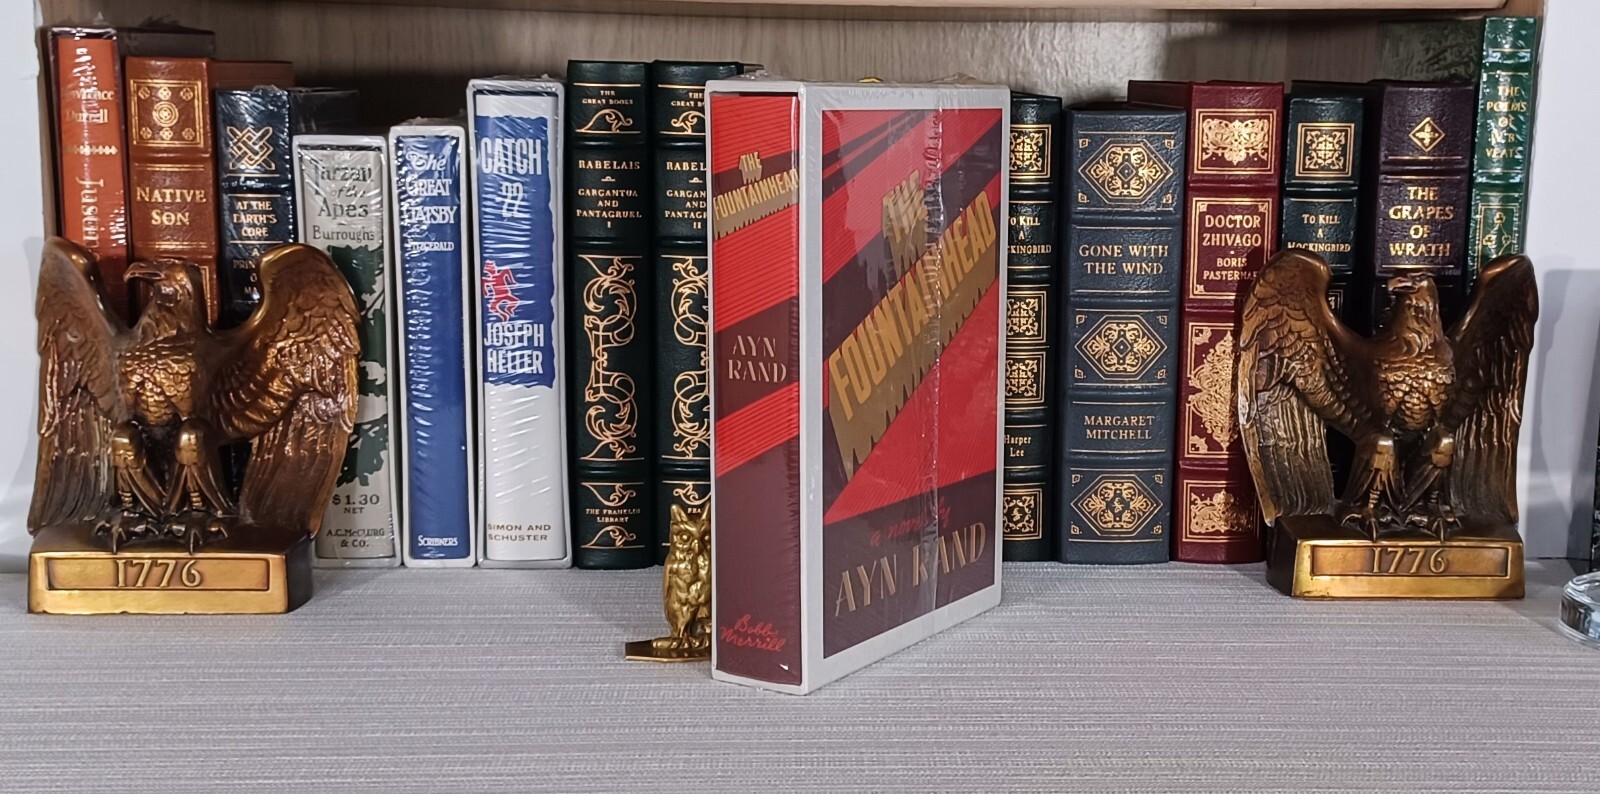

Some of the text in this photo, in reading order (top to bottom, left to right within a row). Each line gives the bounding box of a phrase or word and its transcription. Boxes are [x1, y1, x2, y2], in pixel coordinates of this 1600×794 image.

[1497, 86, 1520, 96] THE
[1486, 101, 1527, 112] POEMS
[405, 151, 447, 171] The
[481, 138, 542, 175] CATCH
[741, 151, 761, 172] THE
[578, 160, 640, 170] RABELAIS
[666, 161, 706, 171] RABEL
[406, 177, 452, 196] GREAT
[578, 188, 638, 197] GARGANTUA
[136, 188, 207, 203] NATIVE
[499, 182, 523, 217] 22
[666, 189, 706, 198] GARGAN
[713, 168, 799, 220] FOUNTAINHEAD
[1407, 187, 1438, 201] THE
[236, 200, 272, 210] AT THE
[318, 197, 369, 219] Apes
[597, 200, 619, 208] AND
[883, 169, 928, 243] THE
[151, 210, 190, 225] SON
[233, 213, 278, 224] EARTH'S
[404, 206, 457, 224] GATSBY
[576, 209, 642, 219] PANTAGRUEL
[664, 210, 707, 219] PANTAG
[1302, 214, 1340, 224] TO KILL
[1389, 205, 1454, 220] GRAPES
[1019, 216, 1040, 226] KILL
[1205, 215, 1261, 228] DOCTOR
[241, 227, 269, 237] CORE
[312, 225, 375, 243] Burroughs
[1317, 228, 1323, 238] A
[1409, 225, 1430, 238] OF
[1202, 233, 1262, 246] ZHIVAGO
[1008, 245, 1052, 254] KINGBIRD
[1079, 244, 1169, 257] GONE WITH
[1389, 243, 1450, 257] WRATH
[233, 260, 256, 269] PRIN
[1083, 262, 1164, 275] THE WIND
[1216, 257, 1247, 267] BORIS
[484, 323, 544, 347] JOSEPH
[733, 335, 776, 358] AYN
[487, 349, 544, 374] HELLER
[728, 359, 787, 383] RAND
[1083, 415, 1155, 427] MARGARET
[1086, 428, 1152, 440] MITCHELL
[1010, 447, 1024, 457] Lee
[488, 533, 548, 541] SCHUSTER
[341, 540, 369, 548] & CO.
[1372, 547, 1447, 574] 1776
[116, 559, 201, 588] 1776
[835, 522, 986, 617] AYN RAND
